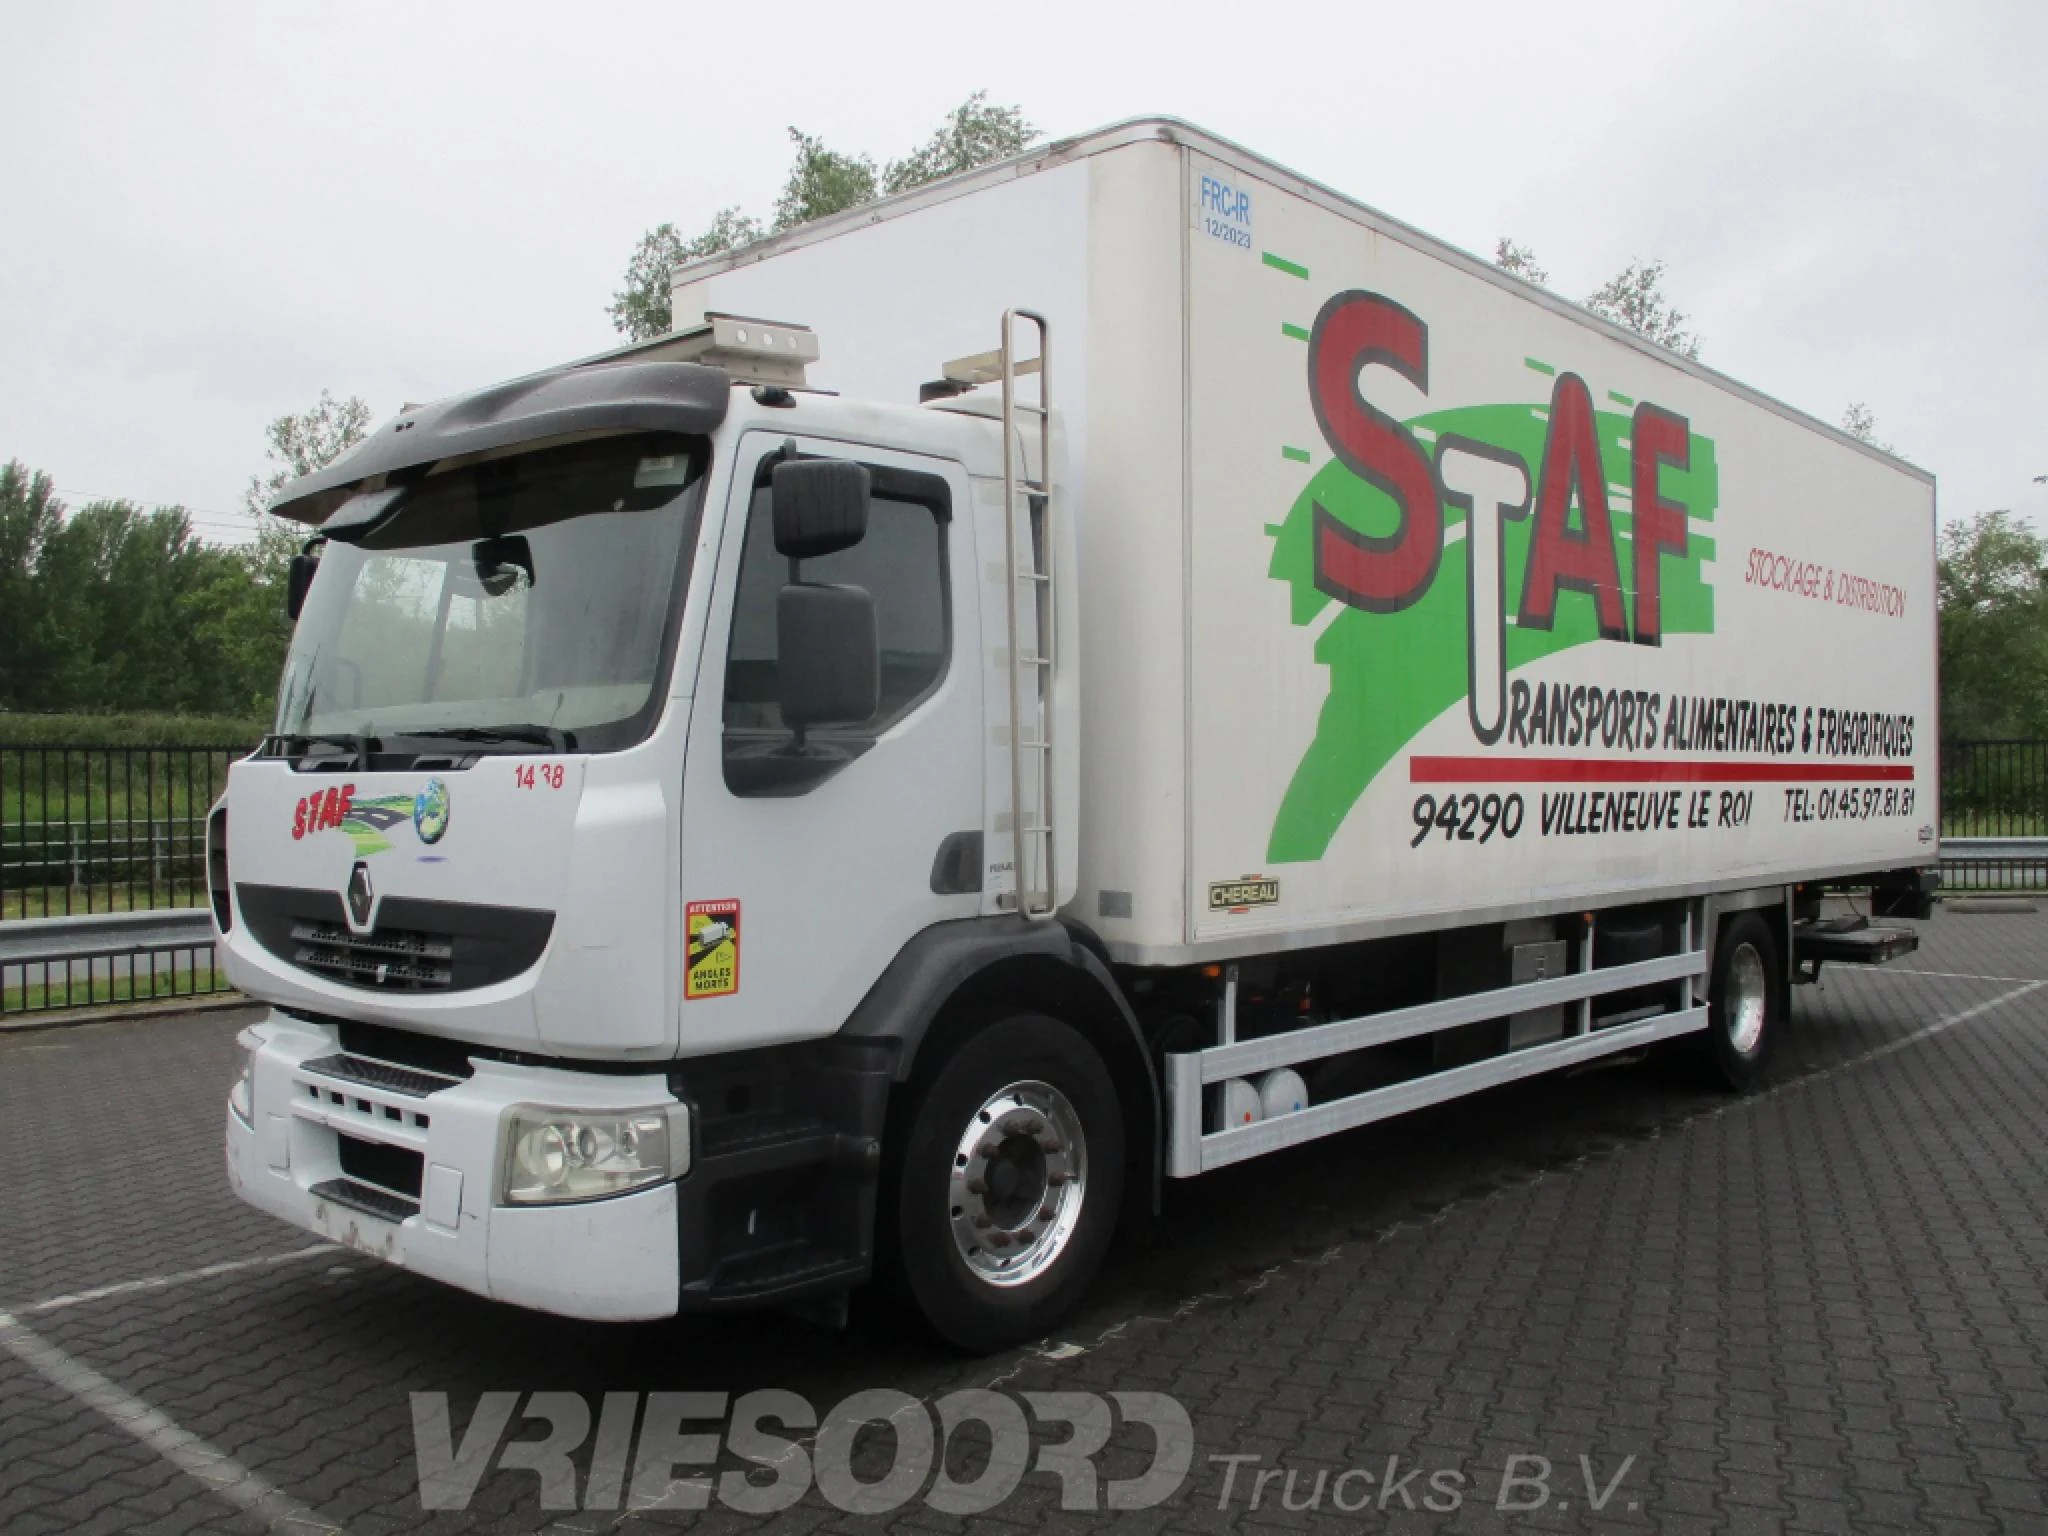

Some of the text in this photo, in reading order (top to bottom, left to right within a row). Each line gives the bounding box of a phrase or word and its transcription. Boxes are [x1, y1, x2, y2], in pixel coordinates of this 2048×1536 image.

[1204, 217, 1251, 249] 12/2023
[1308, 289, 1690, 746] STAF
[1745, 547, 1906, 618] STOCKAGE & DISTRIBUTION
[1663, 694, 1797, 756] ALIMENTAIRES
[1816, 707, 1914, 759] FRIGORIFIQUES
[292, 784, 355, 840] STAF
[1410, 793, 1524, 848] 94290
[1541, 790, 1682, 836] VILLENEUVE
[1687, 790, 1712, 828] LE
[1718, 789, 1753, 828] ROI
[689, 902, 737, 914] ATTENTION
[1210, 881, 1278, 906] CHEREAU
[693, 967, 731, 980] ANGLES
[695, 978, 729, 990] MORTS
